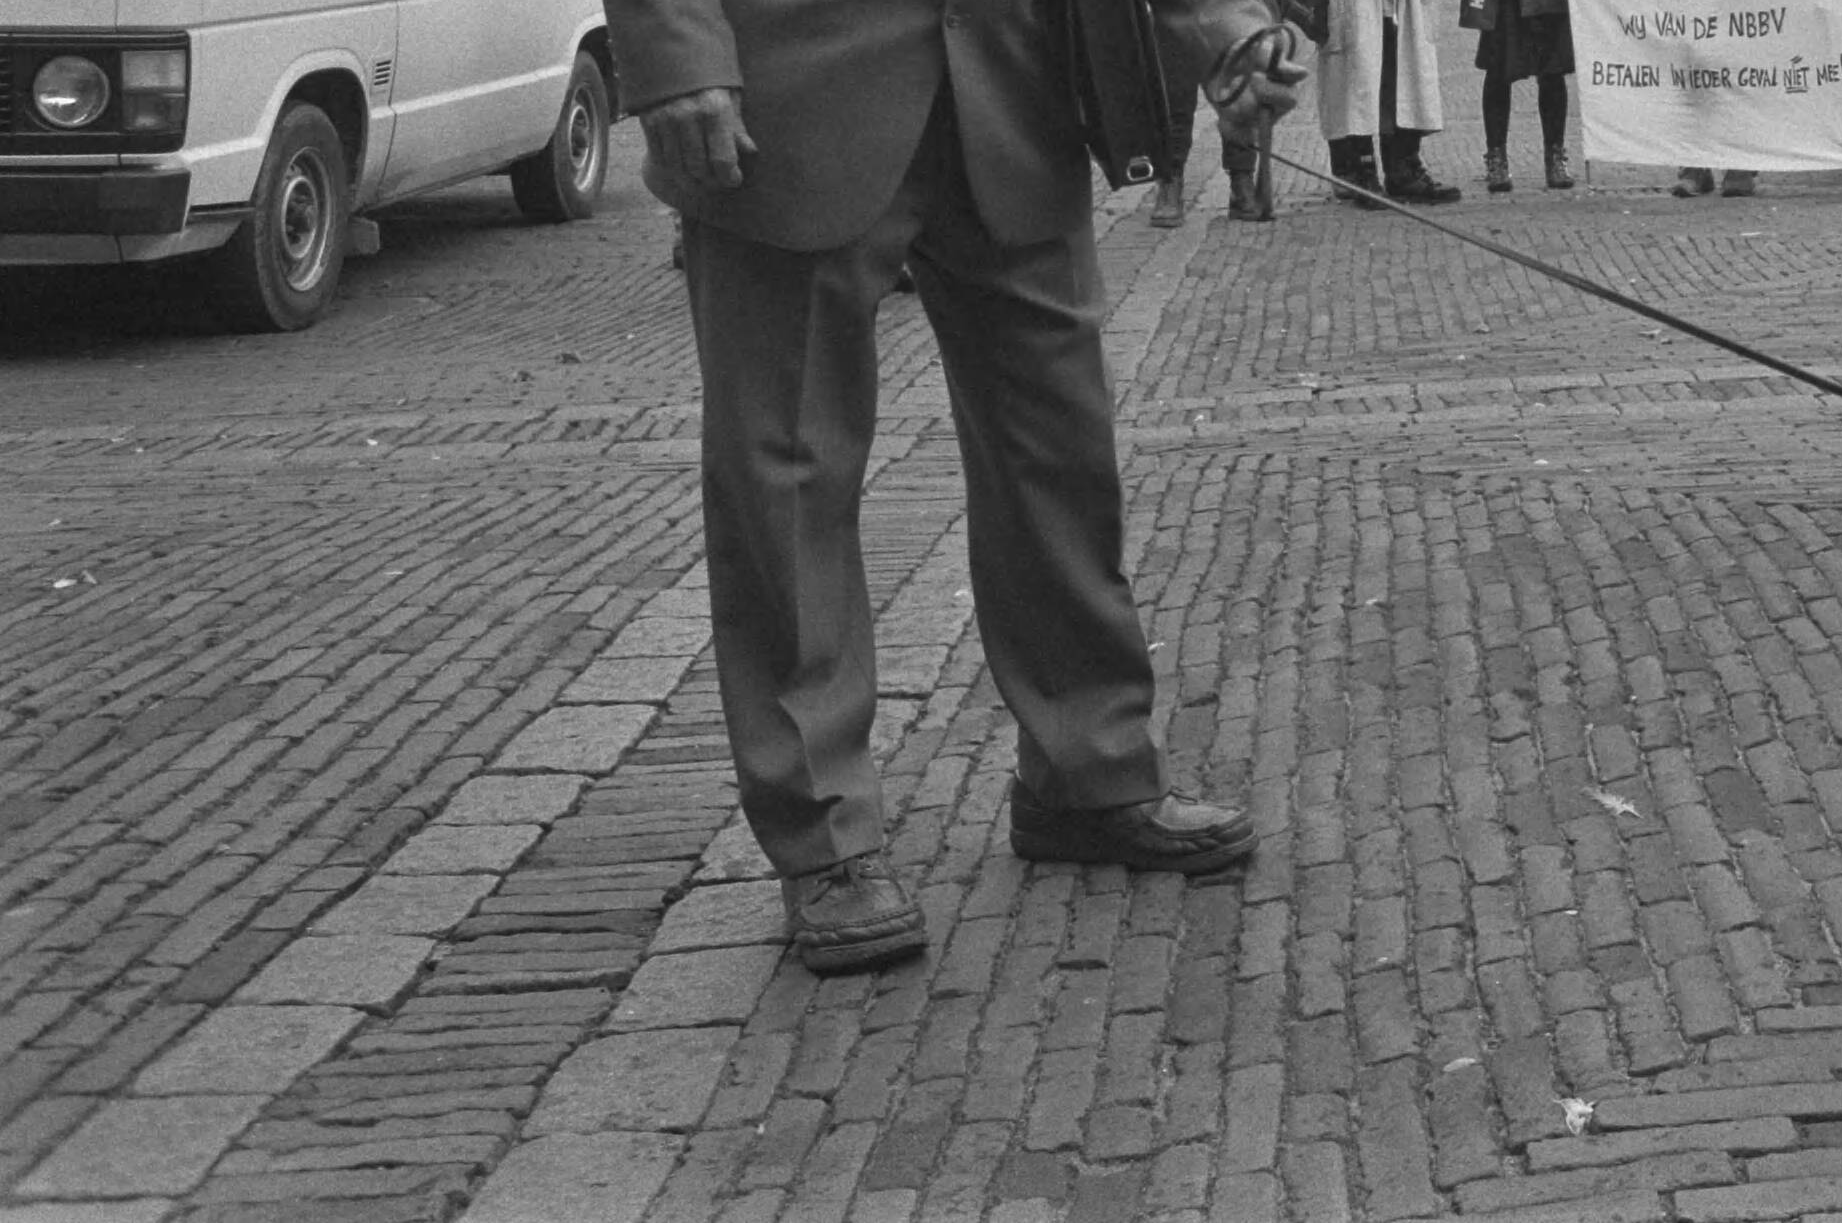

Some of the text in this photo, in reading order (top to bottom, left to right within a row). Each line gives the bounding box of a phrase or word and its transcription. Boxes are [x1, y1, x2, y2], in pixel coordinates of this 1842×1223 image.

[1655, 11, 1686, 37] VAN
[1694, 15, 1718, 40] DE
[1728, 7, 1787, 38] NBBV
[1592, 60, 1660, 88] BETALEN
[1738, 66, 1778, 88] GEVAL
